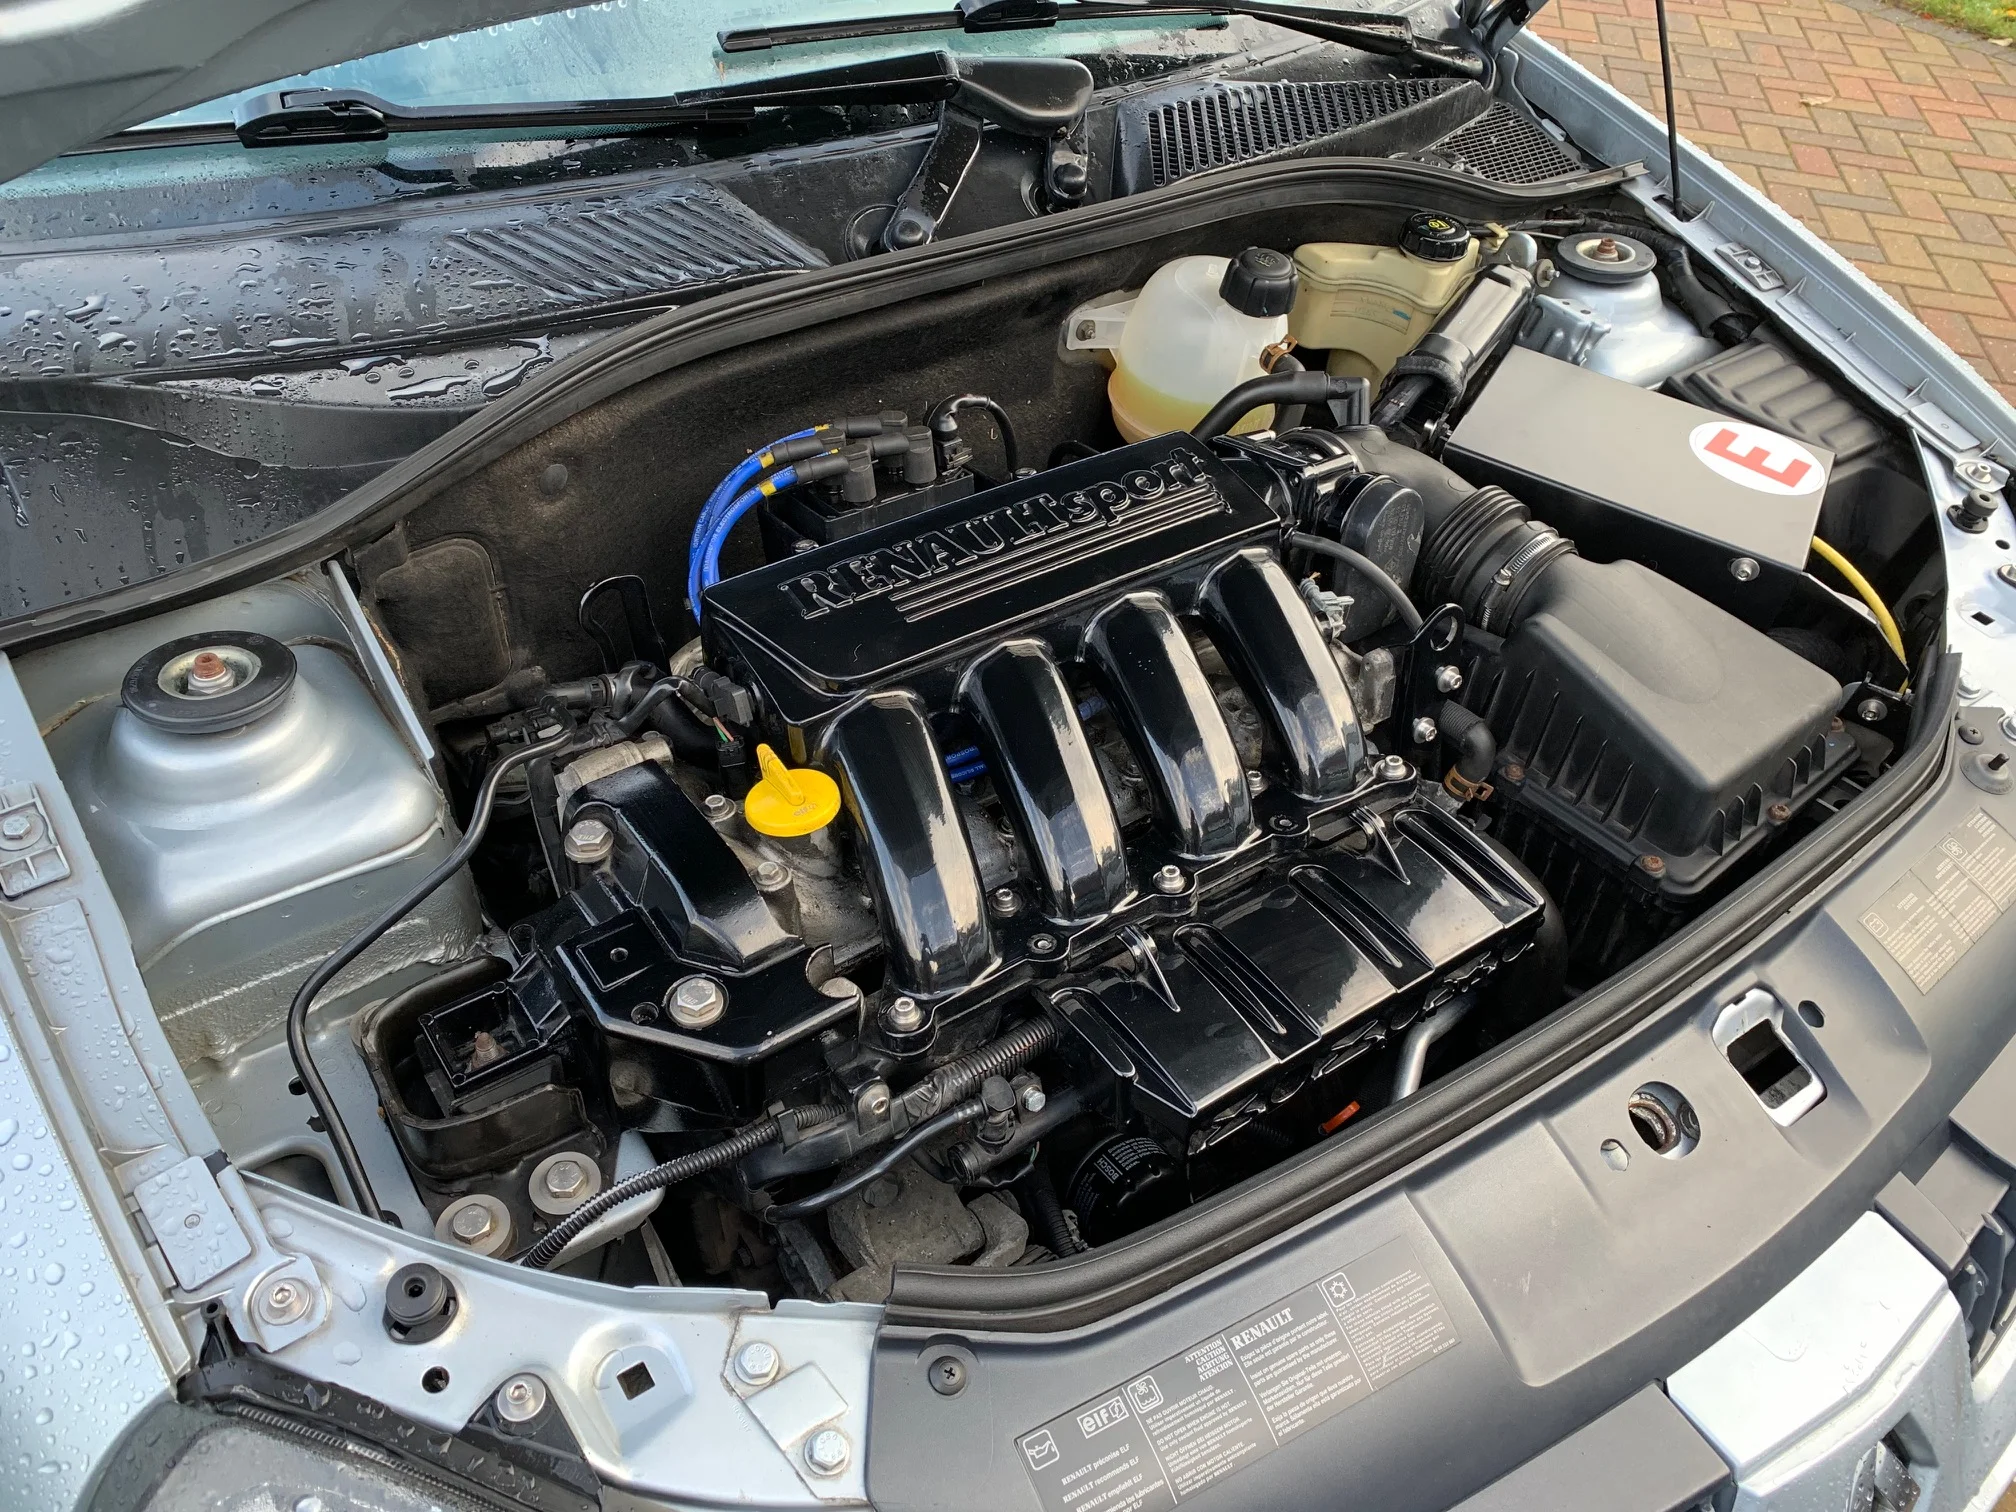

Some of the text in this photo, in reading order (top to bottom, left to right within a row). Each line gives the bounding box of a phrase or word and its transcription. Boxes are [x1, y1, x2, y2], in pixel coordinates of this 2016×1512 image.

[1703, 428, 1812, 488] E
[1097, 1157, 1120, 1180] BOSCH
[1229, 1306, 1295, 1351] RENAULT
[1183, 1338, 1223, 1363] ATTENTION
[1195, 1345, 1226, 1366] CAUTION
[1196, 1351, 1230, 1374] ACHTUNG
[1080, 1408, 1112, 1433] elf
[1060, 1443, 1130, 1484] RENAULT préconise ELF
[1062, 1455, 1140, 1503] RENAULT recommends ELF
[1106, 1478, 1133, 1498] empfiehlt
[1132, 1472, 1143, 1483] ELF
[1125, 1493, 1135, 1504] los
[1134, 1477, 1164, 1499] lubricantes
[1132, 1498, 1143, 1508] ELF
